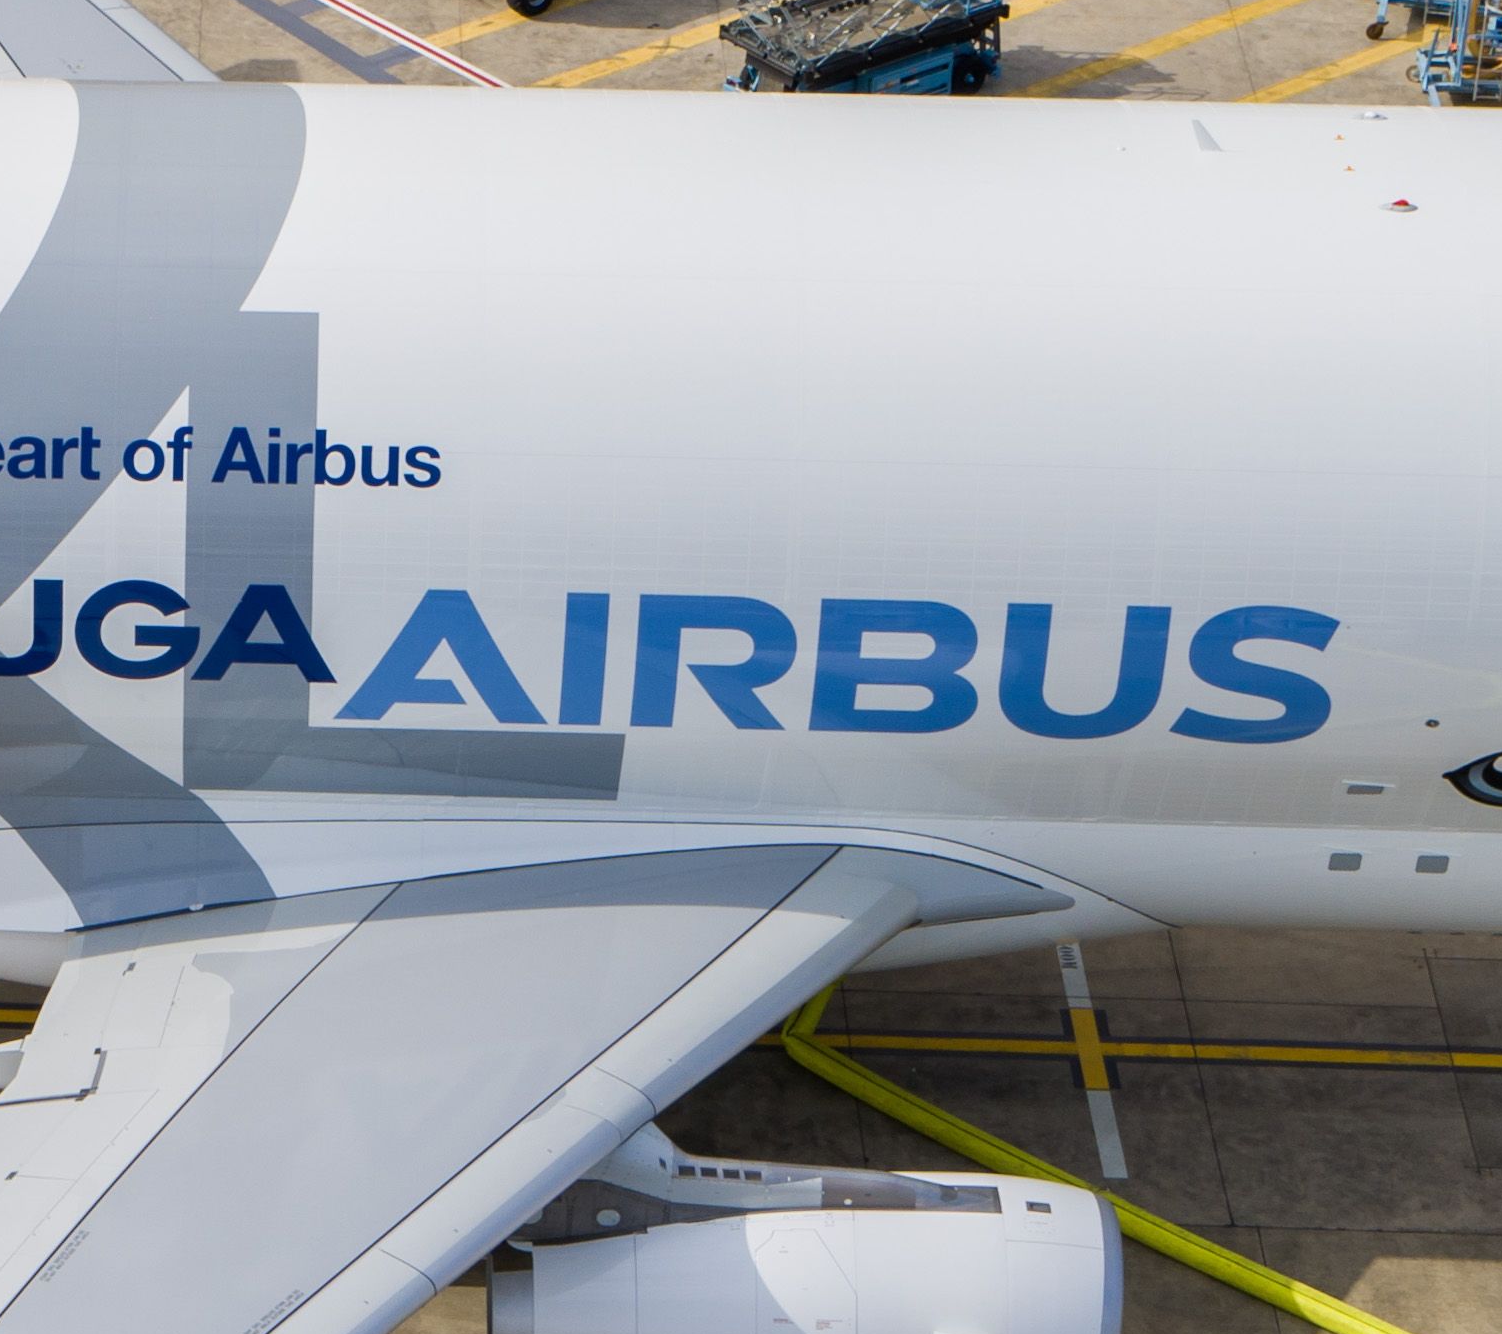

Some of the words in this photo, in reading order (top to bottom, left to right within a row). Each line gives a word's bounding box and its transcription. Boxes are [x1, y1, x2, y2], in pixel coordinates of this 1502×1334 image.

[122, 424, 194, 482] of
[211, 425, 442, 488] Airbus
[333, 588, 1341, 744] AIRBUS
